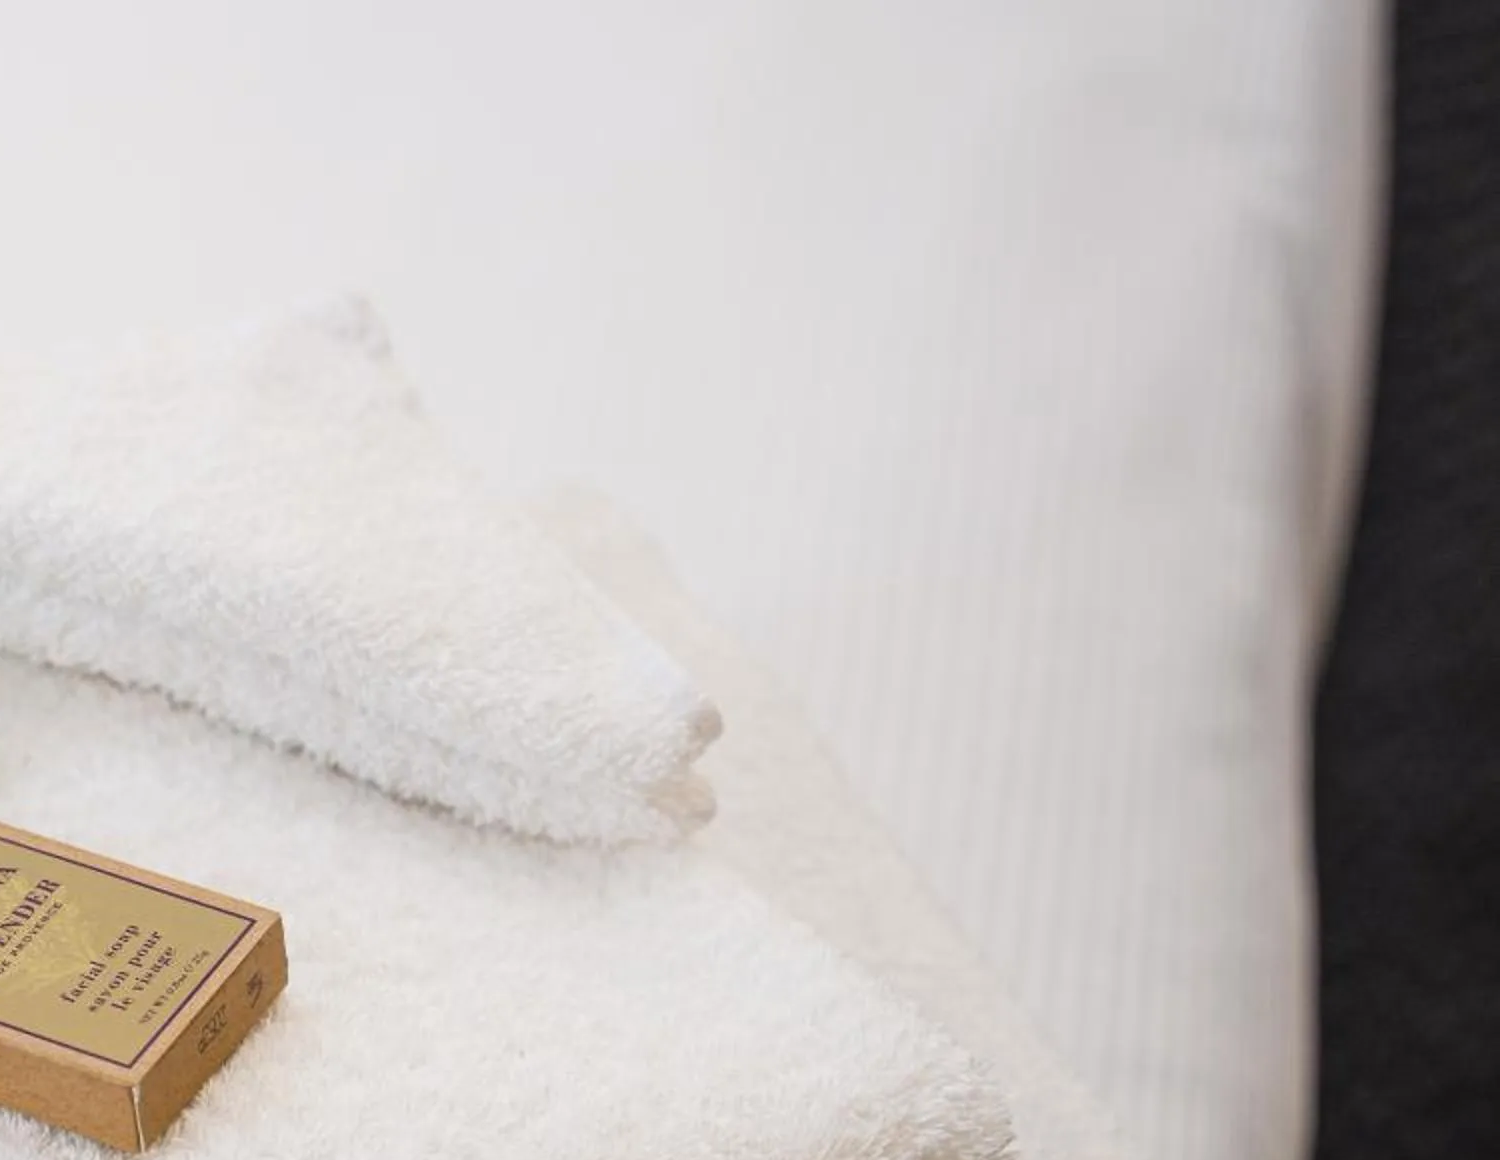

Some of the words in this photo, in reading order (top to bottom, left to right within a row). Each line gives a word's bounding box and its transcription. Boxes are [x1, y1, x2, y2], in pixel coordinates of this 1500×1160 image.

[60, 959, 107, 1004] facial
[104, 924, 140, 960] soap
[87, 970, 130, 1012] savon
[128, 930, 163, 968] pour
[110, 996, 135, 1012] le
[131, 946, 176, 992] visage
